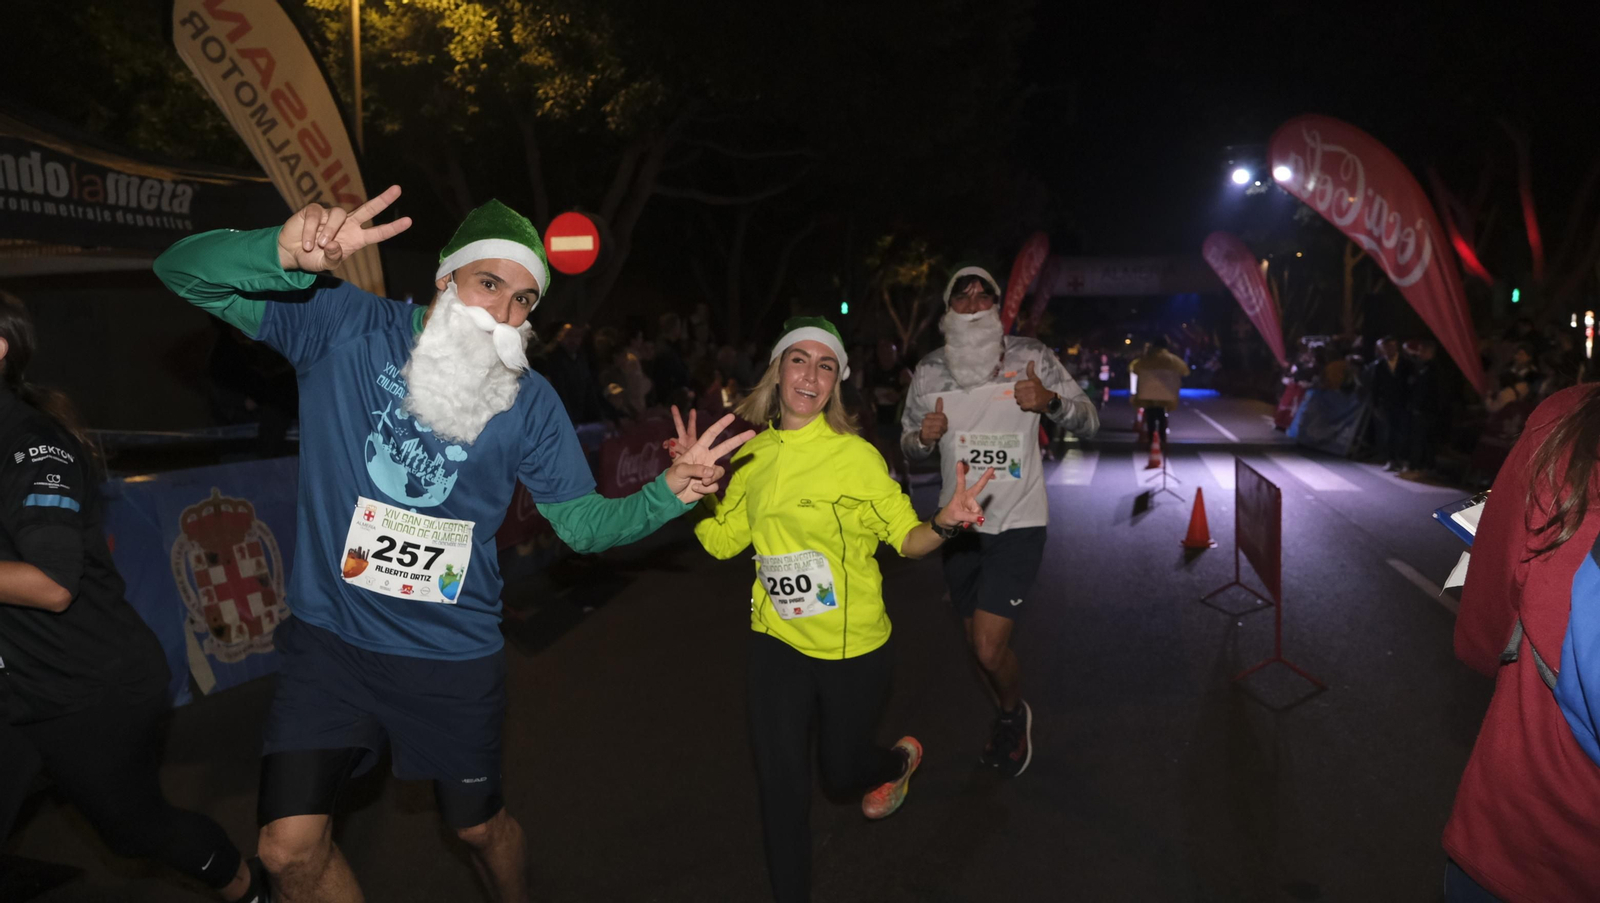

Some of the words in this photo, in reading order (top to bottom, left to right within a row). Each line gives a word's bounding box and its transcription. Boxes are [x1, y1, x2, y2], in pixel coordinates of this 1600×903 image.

[115, 210, 193, 230] deportivo
[383, 361, 400, 379] XIV
[28, 445, 74, 463] DEKTON
[970, 449, 1008, 465] 259
[381, 518, 416, 536] CIUDAD
[417, 528, 430, 539] DE
[384, 507, 400, 519] XIV
[401, 513, 422, 526] SAN
[423, 519, 470, 533] SILVESTRE
[371, 535, 445, 571] 257
[375, 565, 409, 579] ALBERTO
[410, 572, 432, 582] ORTIZ
[767, 574, 812, 596] 260
